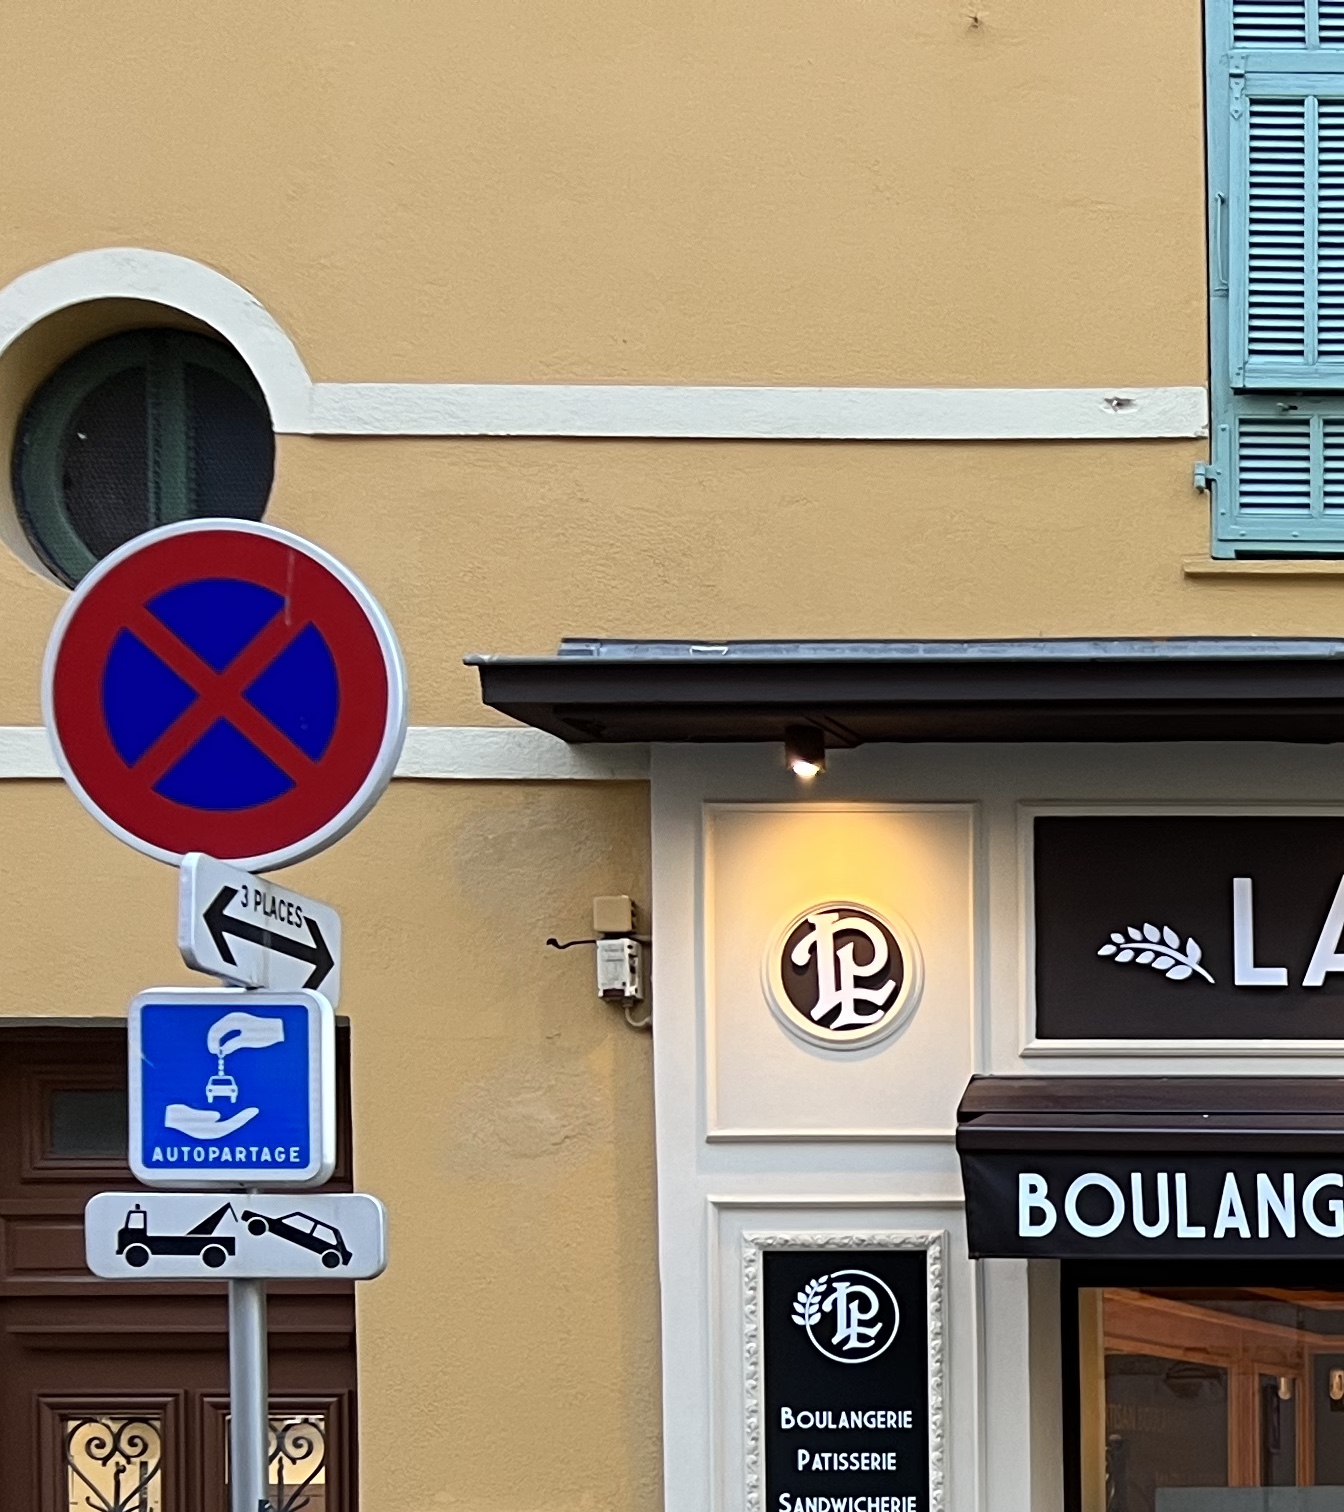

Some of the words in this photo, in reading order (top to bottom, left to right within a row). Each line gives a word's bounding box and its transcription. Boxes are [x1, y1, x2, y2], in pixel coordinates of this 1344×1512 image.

[240, 884, 250, 909] 3
[250, 888, 304, 930] PLACES
[152, 1144, 301, 1165] AUTOPARTAGE
[780, 1405, 914, 1431] BOULANGERIE
[797, 1449, 898, 1473] PATISSERIE
